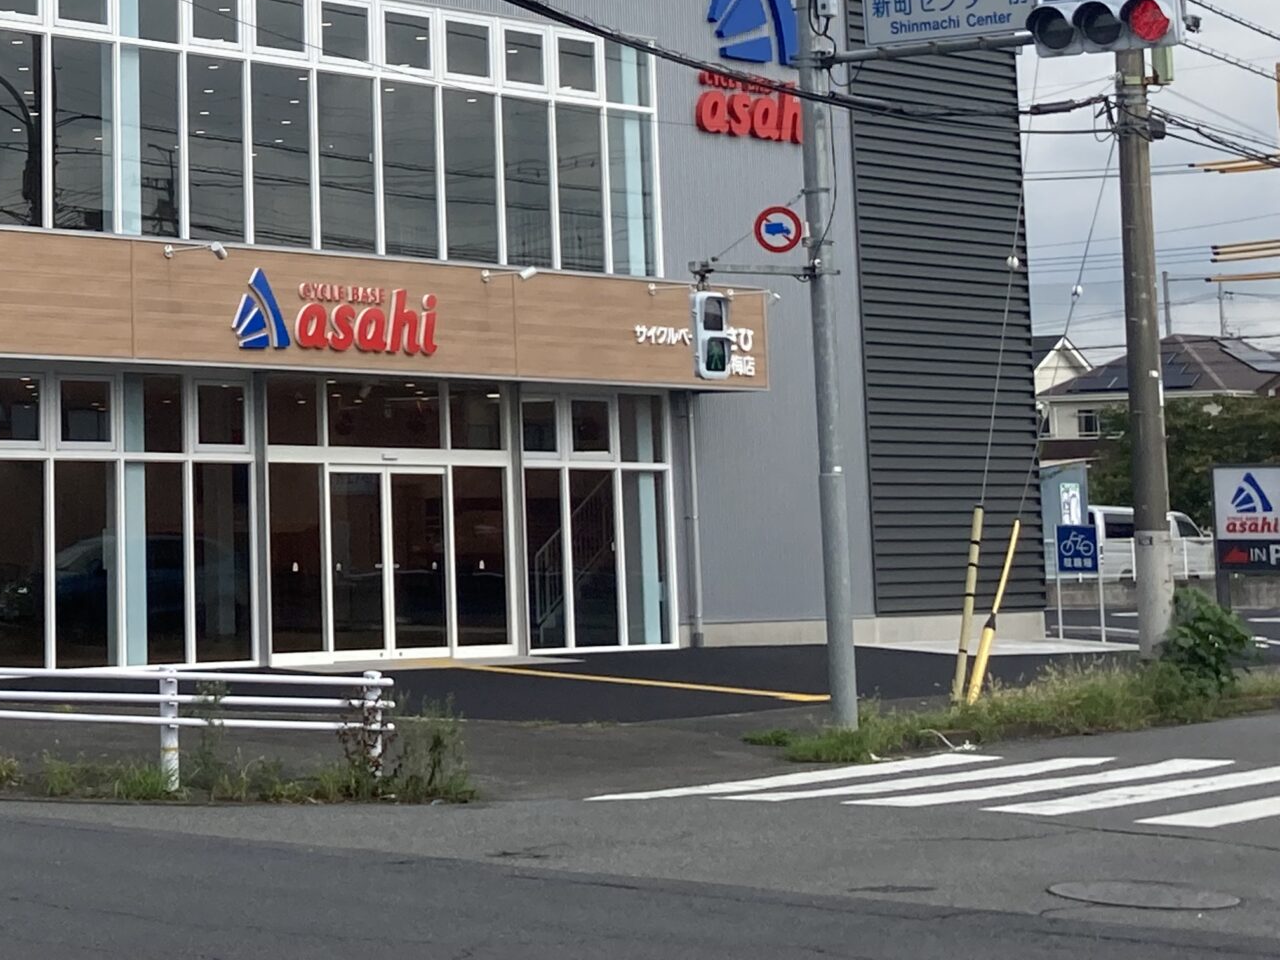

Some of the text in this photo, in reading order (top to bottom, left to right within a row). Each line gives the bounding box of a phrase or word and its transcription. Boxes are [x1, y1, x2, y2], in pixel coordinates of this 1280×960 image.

[890, 12, 1012, 35] Shinmachi Center
[696, 81, 803, 144] asah
[299, 282, 385, 305] CYCLE BASE
[295, 288, 437, 356] asahi
[1226, 516, 1279, 533] asahi
[1250, 547, 1267, 562] IN
